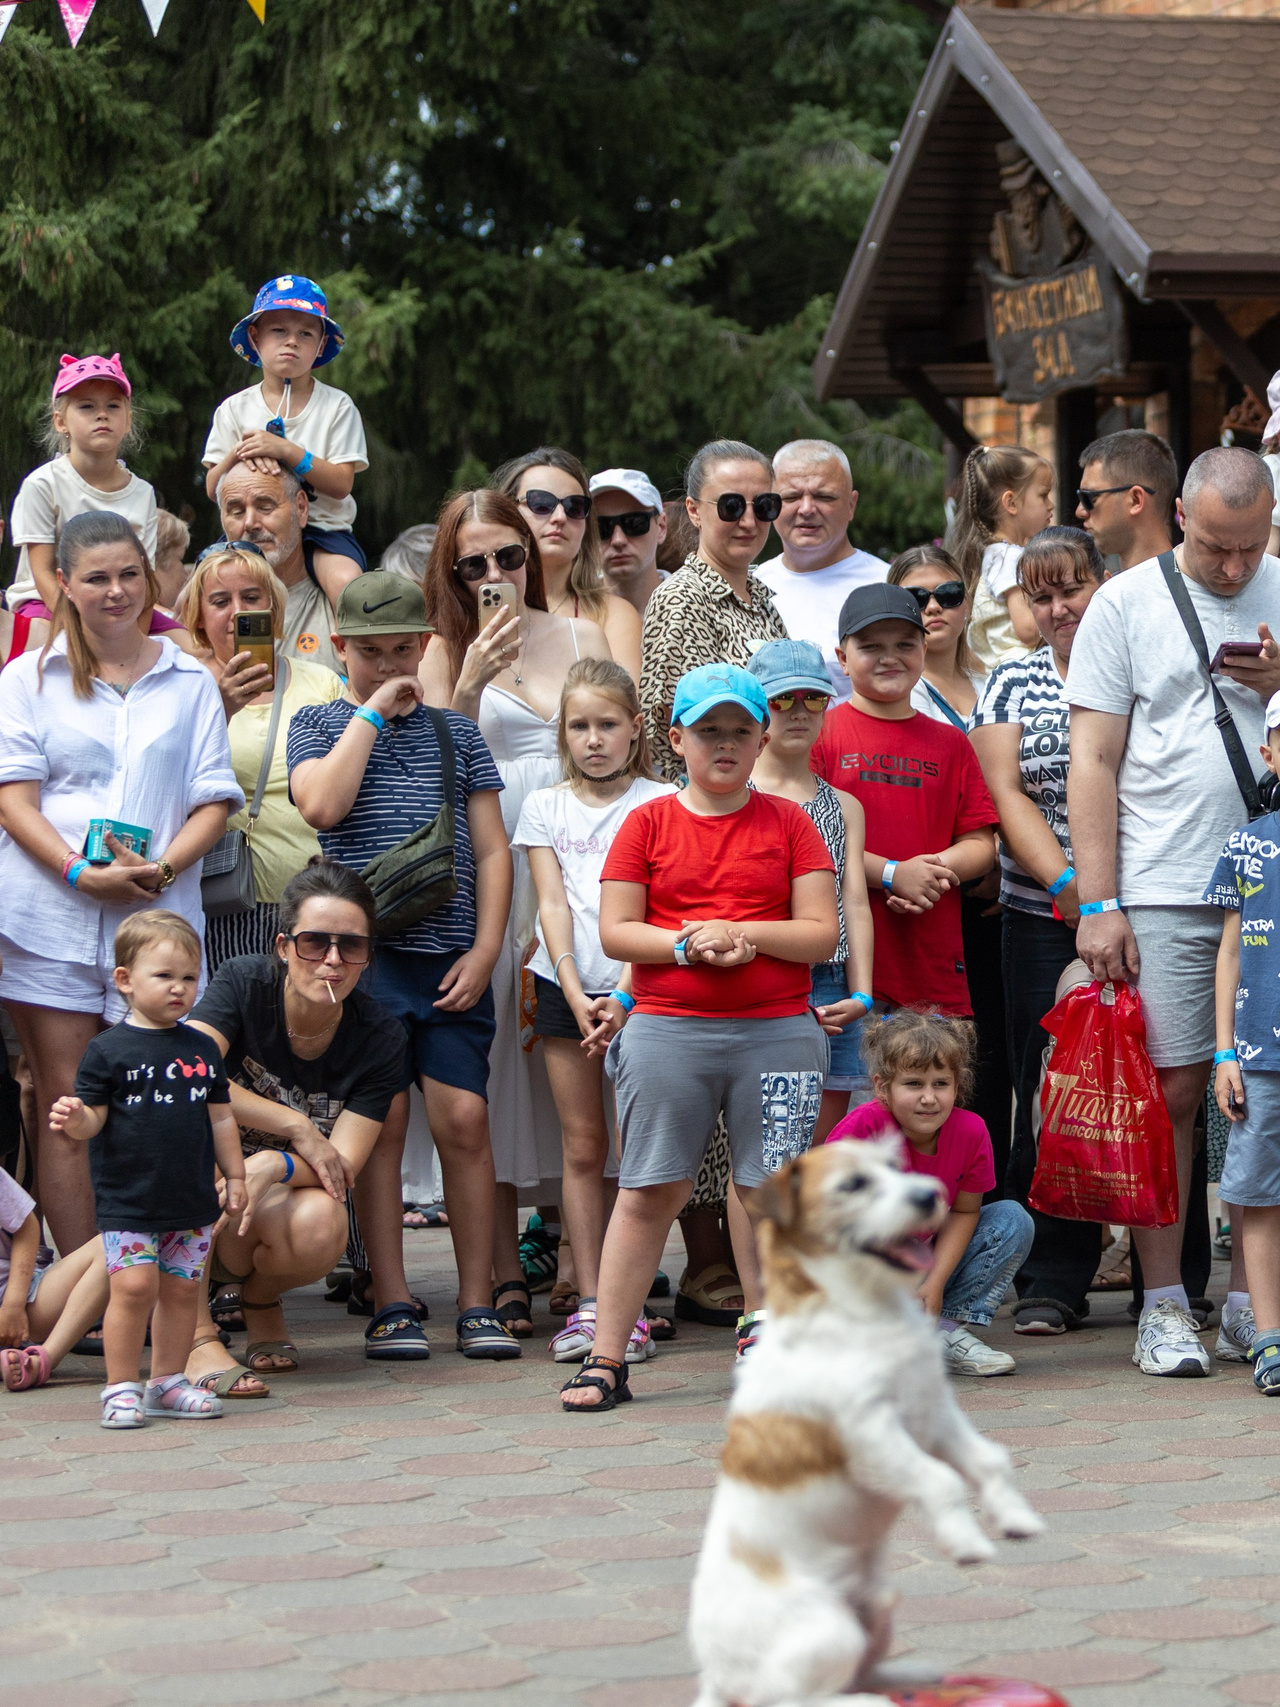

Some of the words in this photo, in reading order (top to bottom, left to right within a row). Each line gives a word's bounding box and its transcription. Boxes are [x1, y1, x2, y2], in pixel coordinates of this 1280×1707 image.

[1215, 884, 1237, 895] HERE
[1206, 893, 1239, 907] RULES
[1242, 935, 1269, 947] FUN
[126, 1064, 155, 1081] IT'S
[126, 1093, 142, 1105] to
[154, 1089, 174, 1104] be
